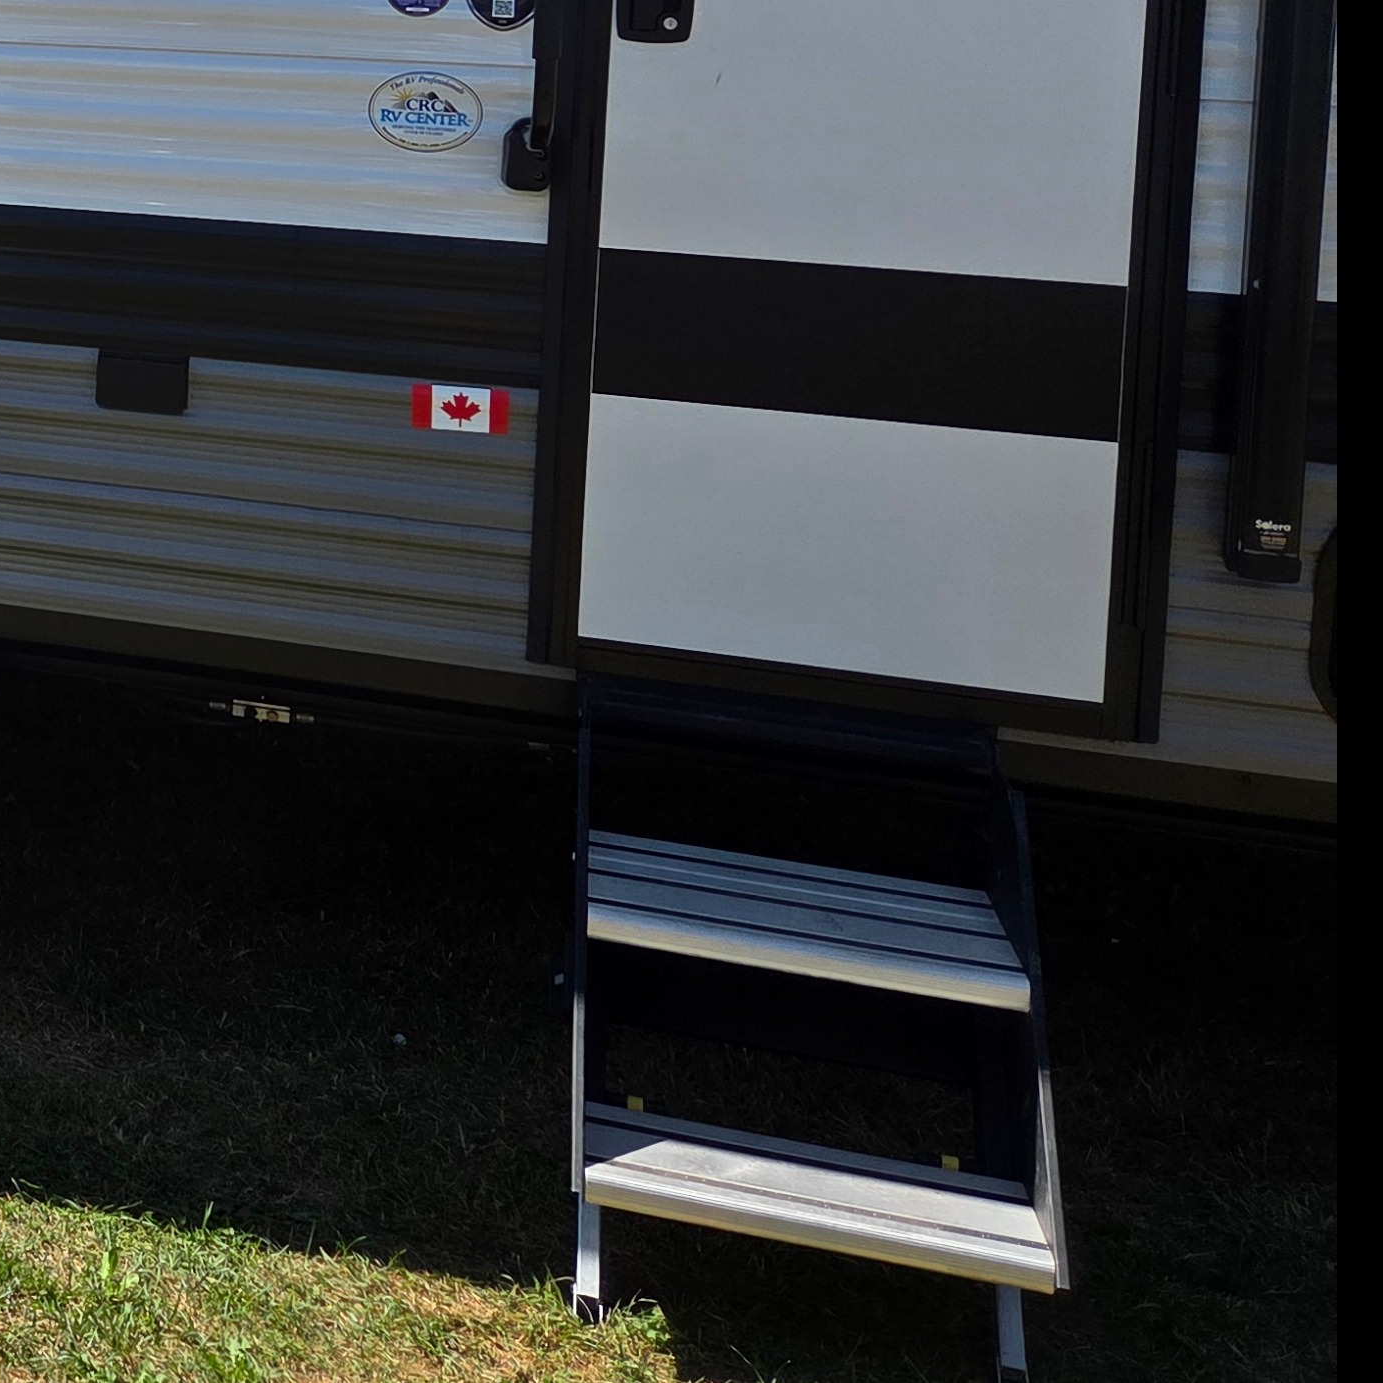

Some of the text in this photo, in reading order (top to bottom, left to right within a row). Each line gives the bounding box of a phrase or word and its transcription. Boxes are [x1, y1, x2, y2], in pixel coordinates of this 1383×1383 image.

[405, 98, 445, 113] CRC
[380, 109, 403, 123] RV
[404, 111, 471, 128] CENTER
